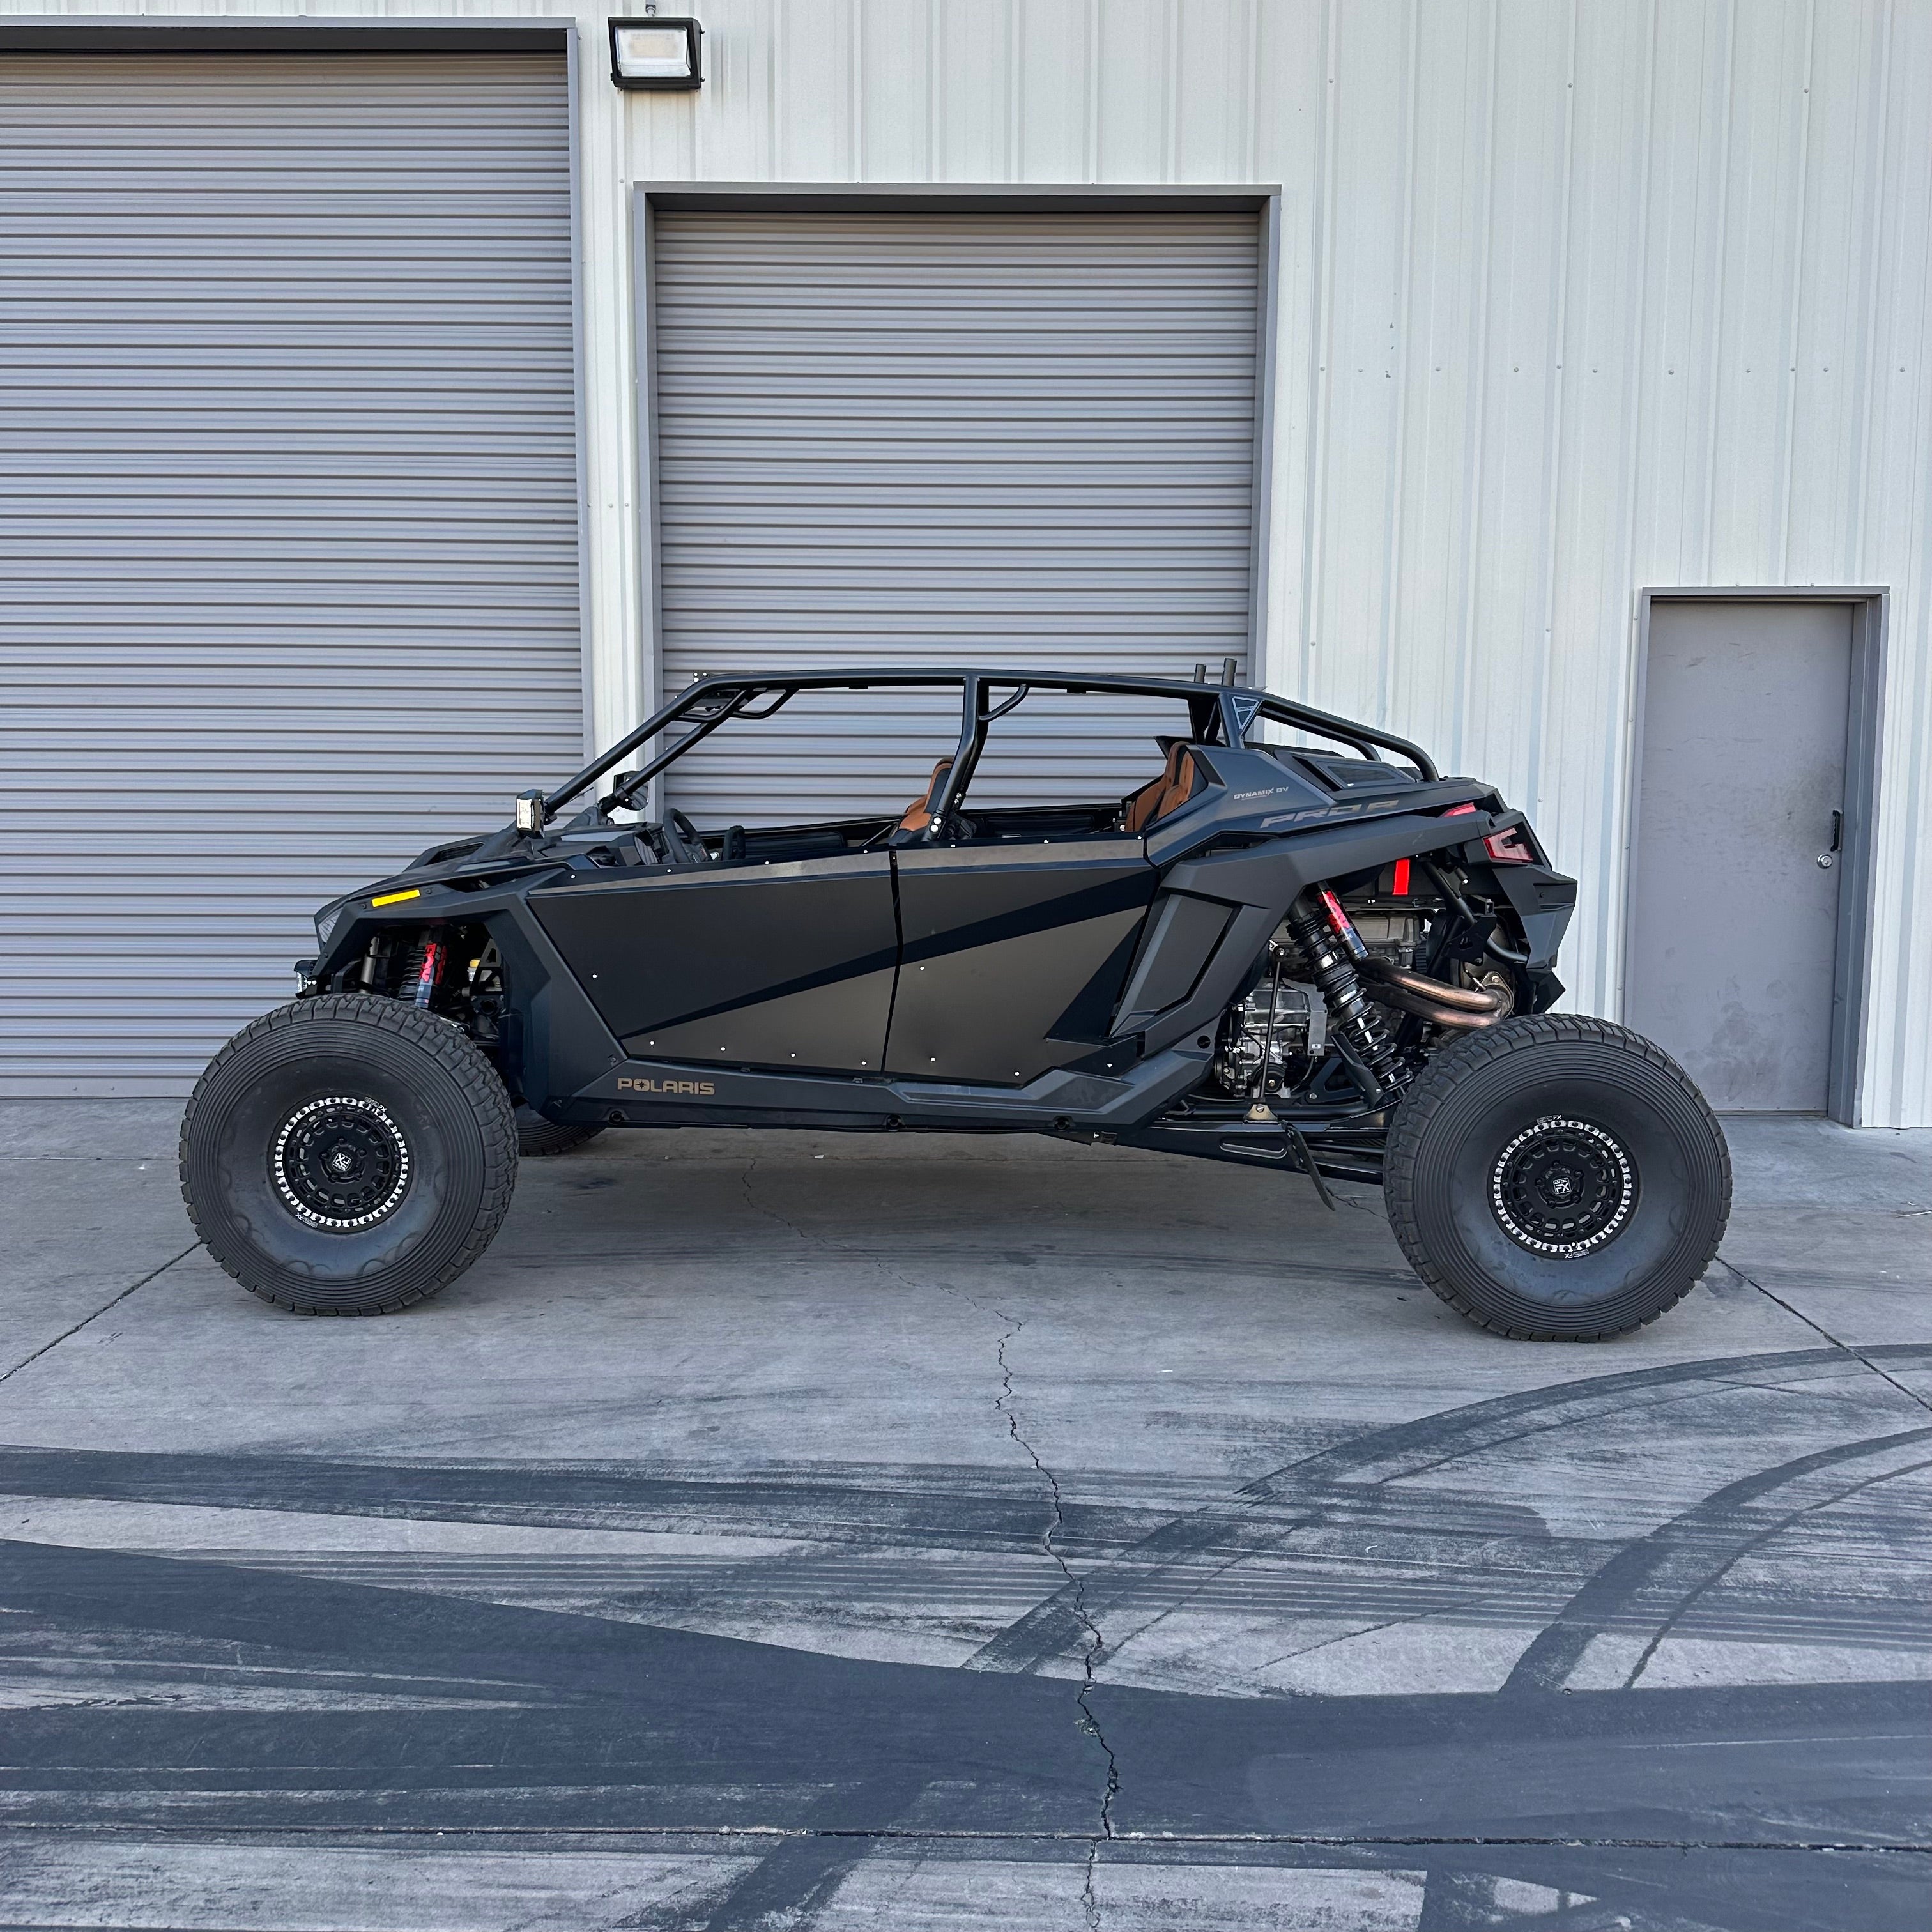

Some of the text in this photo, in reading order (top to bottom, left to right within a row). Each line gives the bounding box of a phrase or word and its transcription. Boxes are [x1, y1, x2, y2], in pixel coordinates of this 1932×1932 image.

[1234, 787, 1275, 800] DYNAMIX
[1260, 799, 1400, 829] PRO R
[617, 1077, 715, 1095] POLARIS
[1555, 1182, 1570, 1193] FX
